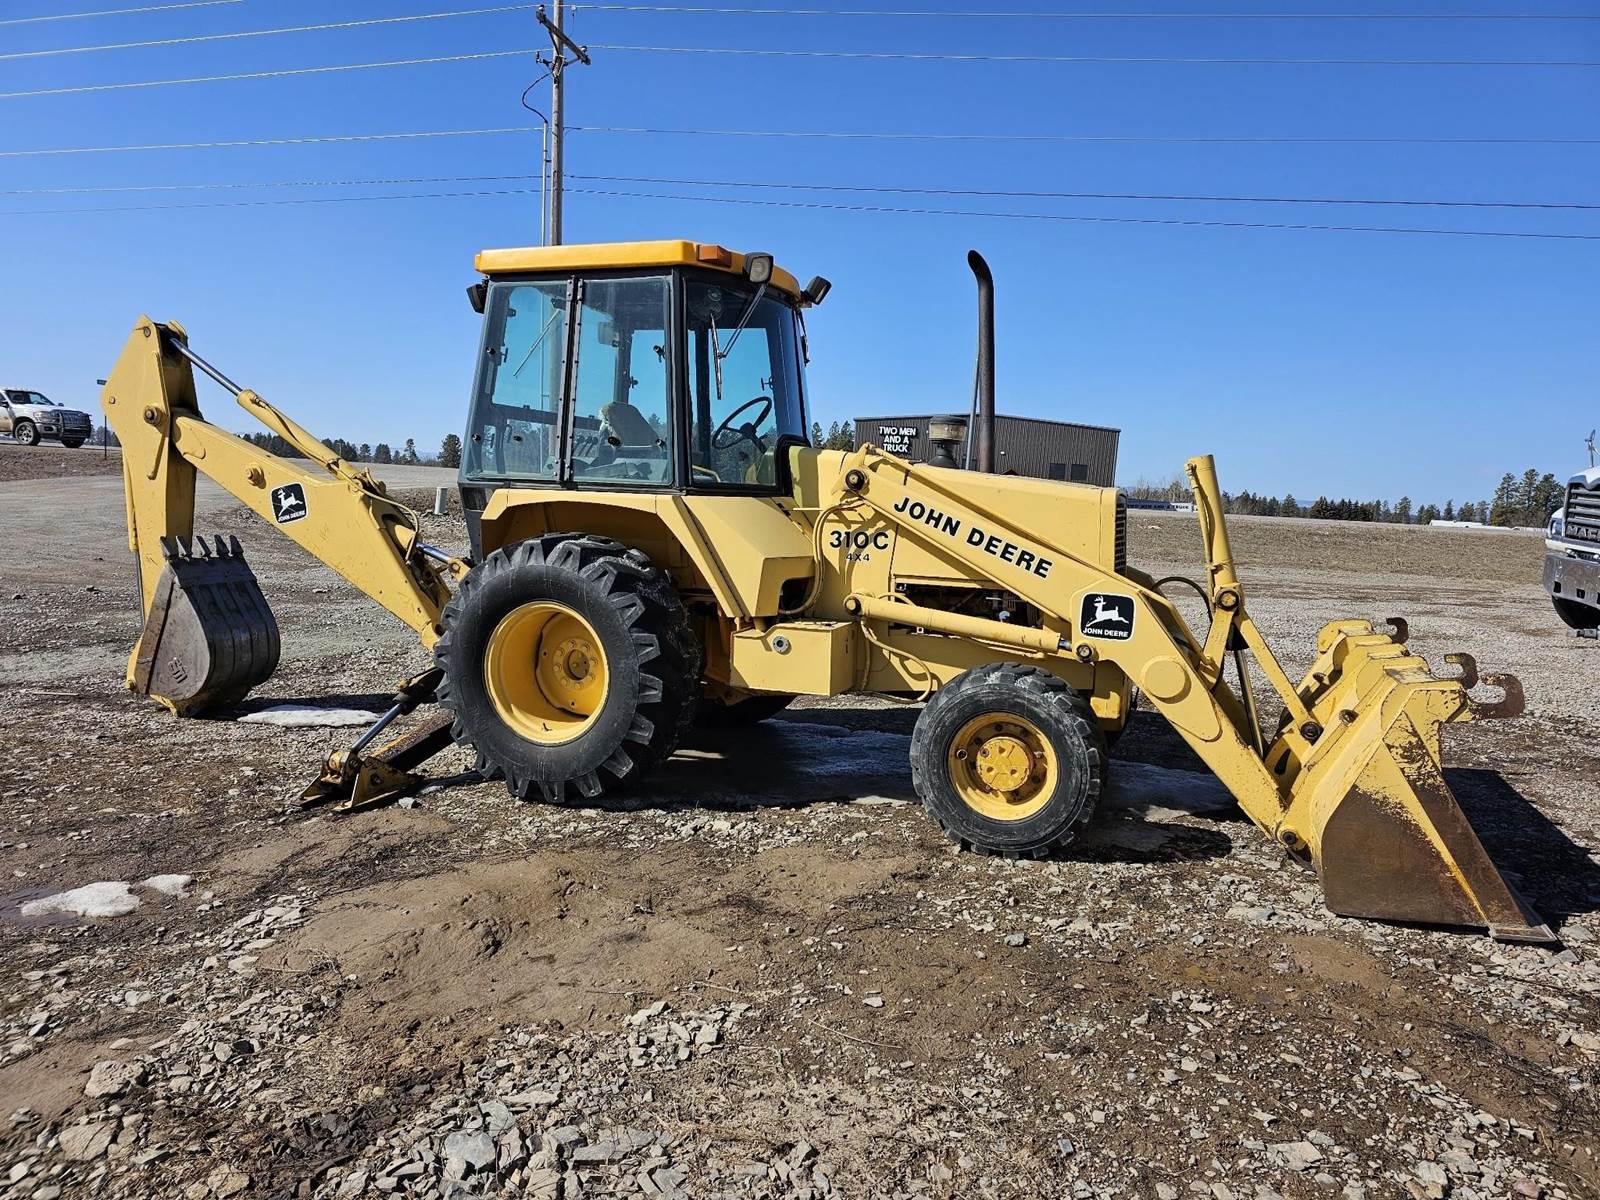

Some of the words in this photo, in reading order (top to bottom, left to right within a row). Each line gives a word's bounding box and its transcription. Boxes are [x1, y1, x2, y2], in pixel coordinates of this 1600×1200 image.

[879, 426, 897, 435] TWO
[899, 427, 916, 436] MEN
[884, 435, 901, 444] AND
[903, 436, 909, 444] A
[883, 443, 908, 452] TRUCK
[829, 530, 889, 550] 310C
[893, 497, 961, 537] JOHN
[966, 527, 1053, 578] DEERE
[1083, 627, 1103, 635] JOHN
[1104, 629, 1129, 637] DEERE
